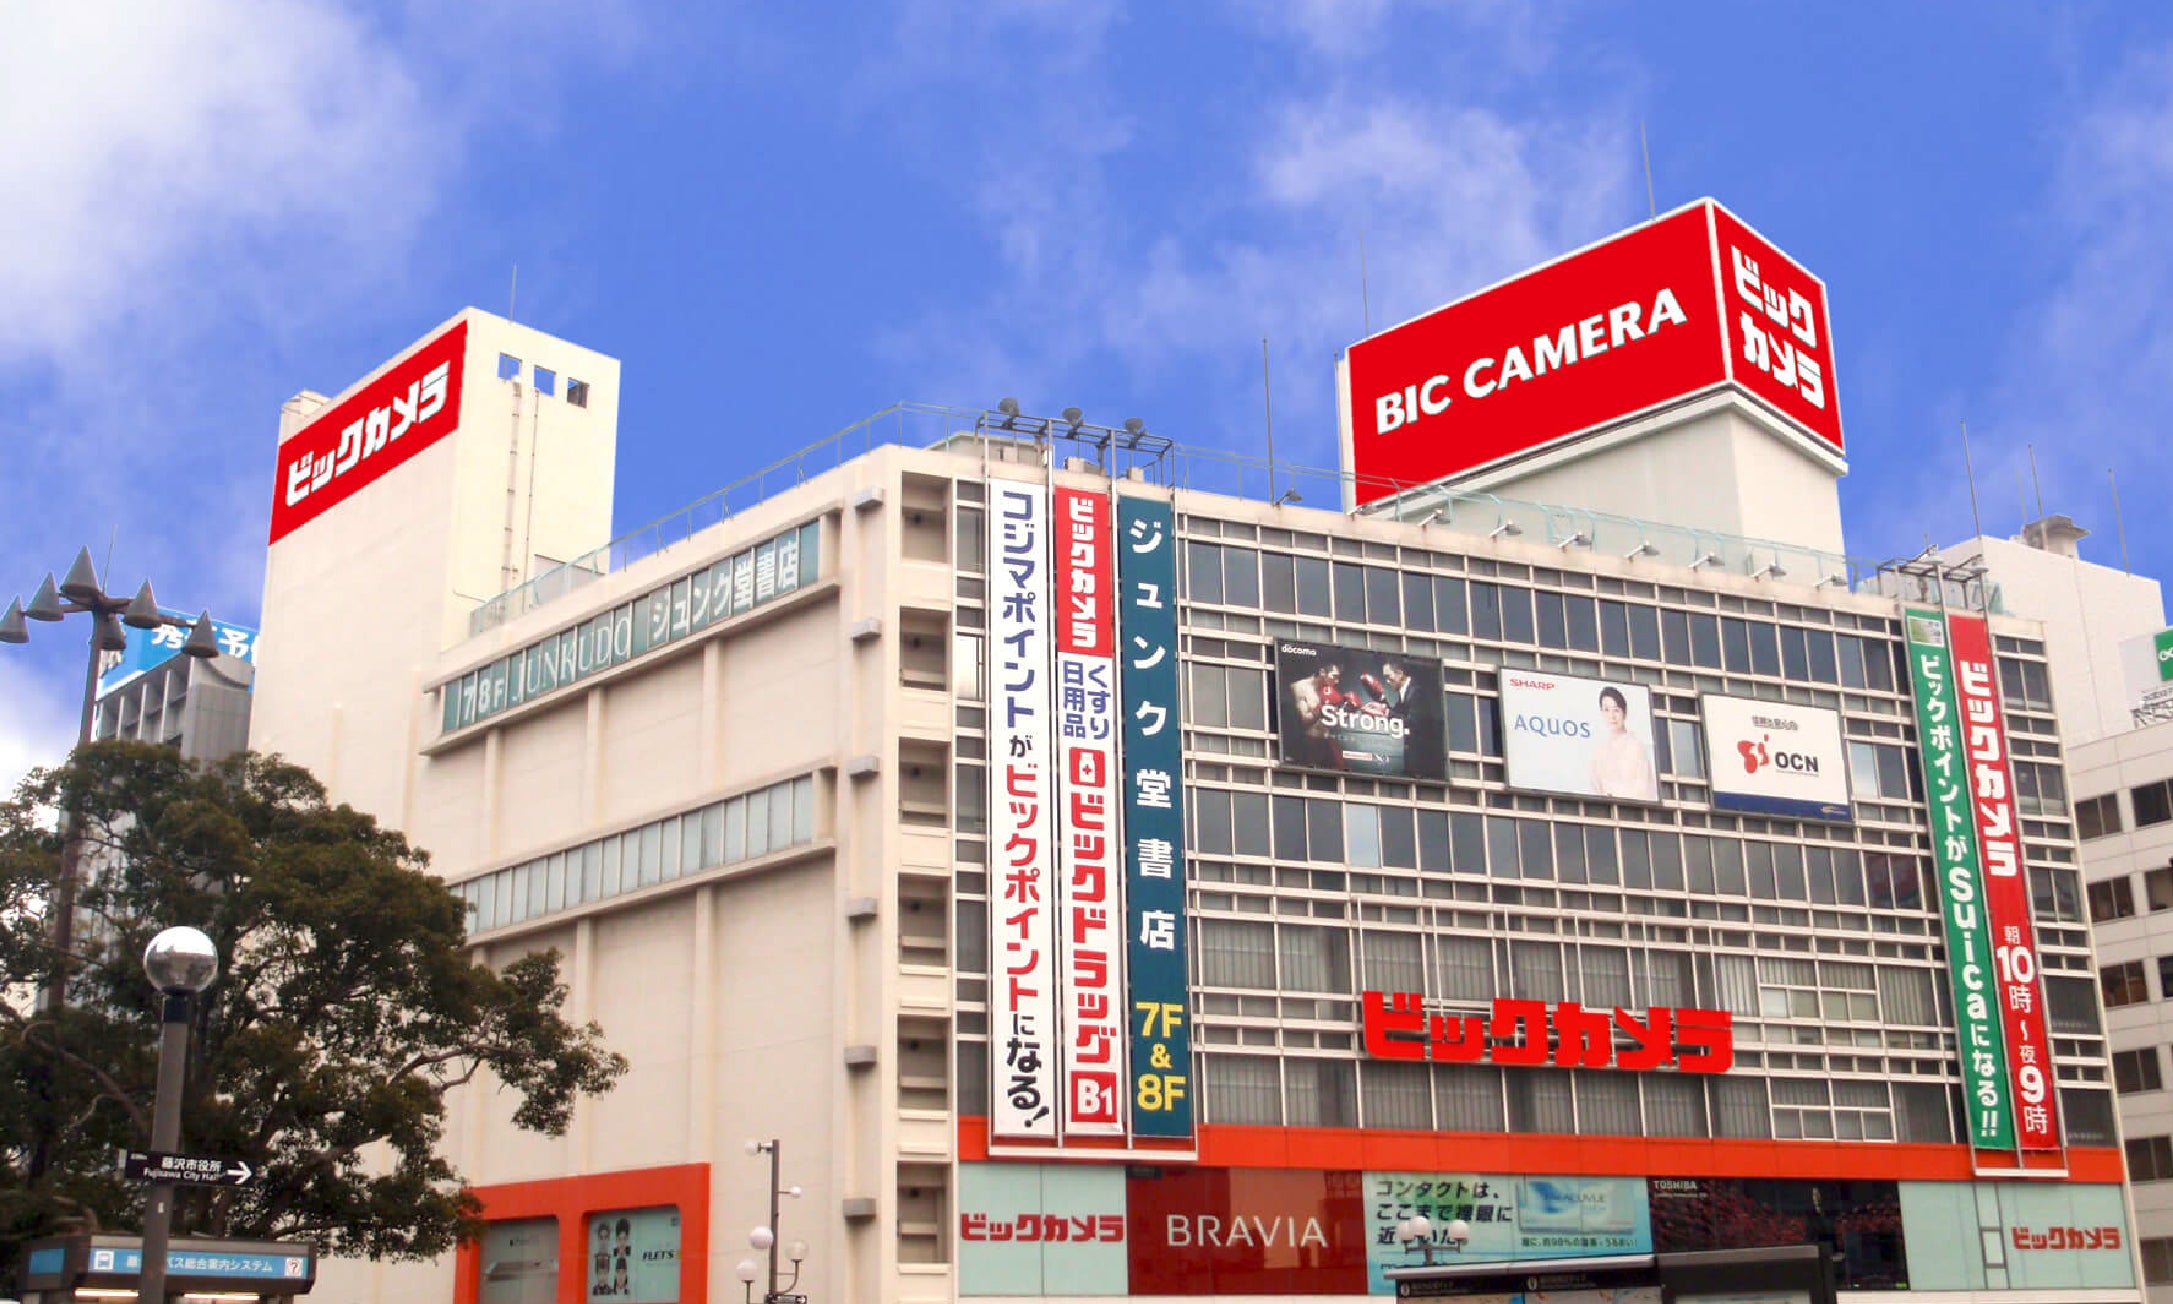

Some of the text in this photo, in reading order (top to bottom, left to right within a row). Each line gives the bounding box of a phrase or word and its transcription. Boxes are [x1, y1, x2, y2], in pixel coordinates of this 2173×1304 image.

[1731, 244, 1818, 349] ビック
[1376, 287, 1688, 434] BIC CAMERA
[1740, 311, 1826, 410] カメラ
[286, 359, 450, 507] ビックカメラ
[1068, 495, 1097, 649] ビックカメラ
[1062, 660, 1086, 739] 日用品
[1087, 664, 1111, 741] くすり
[1510, 678, 1555, 691] SHARP
[1130, 517, 1176, 951] ジュンク堂書店
[1321, 705, 1411, 738] Strong.
[1514, 713, 1591, 738] AQUOS
[1775, 751, 1819, 773] OCN
[1959, 659, 2017, 877] ビックカメラ
[1069, 793, 1117, 1064] ビックドラッグ
[1136, 1001, 1184, 1039] 7F
[1362, 990, 1733, 1074] ビックカメラ
[1149, 1043, 1172, 1069] &
[1077, 1077, 1114, 1117] B1
[1137, 1073, 1187, 1112] 8F
[1653, 1180, 1698, 1190] TOSHIBA
[960, 1213, 1126, 1242] ビックカメラ
[1166, 1214, 1328, 1248] BRAVIA
[2011, 1226, 2121, 1251] ビックカメラ
